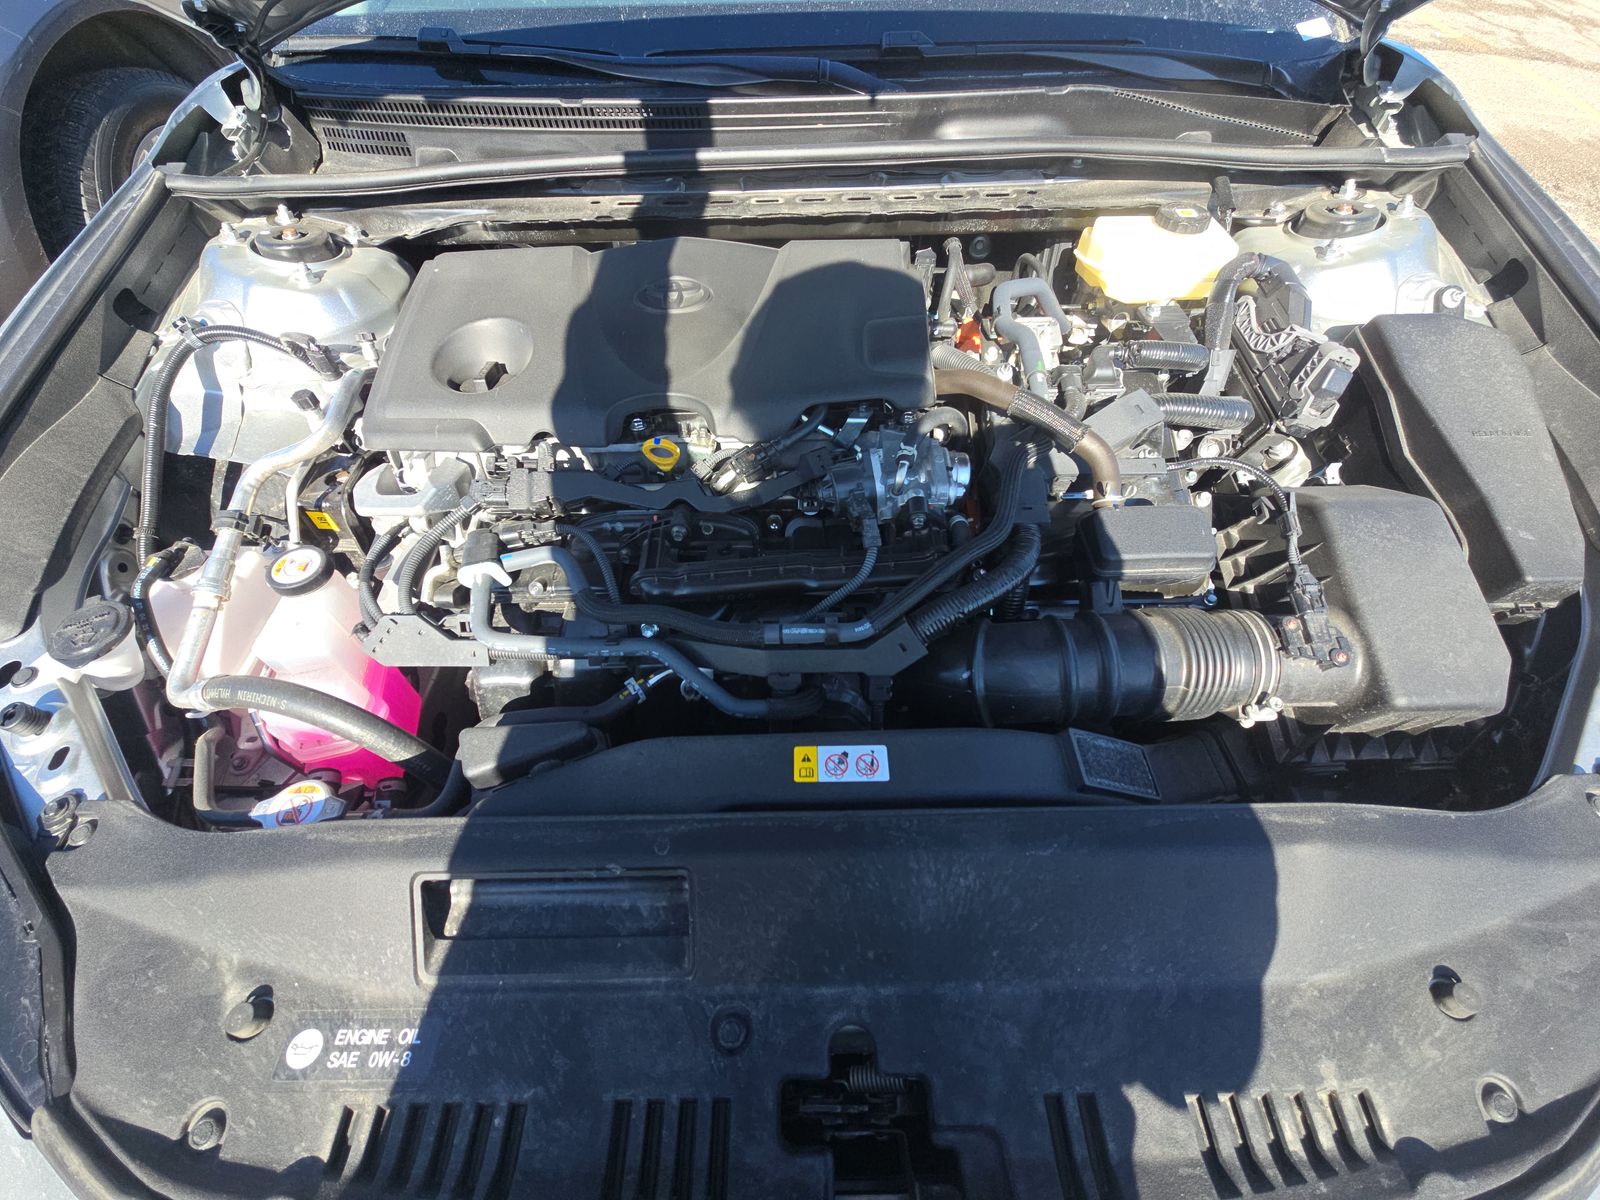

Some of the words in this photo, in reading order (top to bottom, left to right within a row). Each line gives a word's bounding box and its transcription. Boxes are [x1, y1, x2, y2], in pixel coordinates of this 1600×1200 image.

[334, 1028, 392, 1045] ENGINE
[398, 1028, 421, 1045] OIL
[326, 1051, 361, 1068] SAE
[368, 1050, 412, 1068] 0W-8
